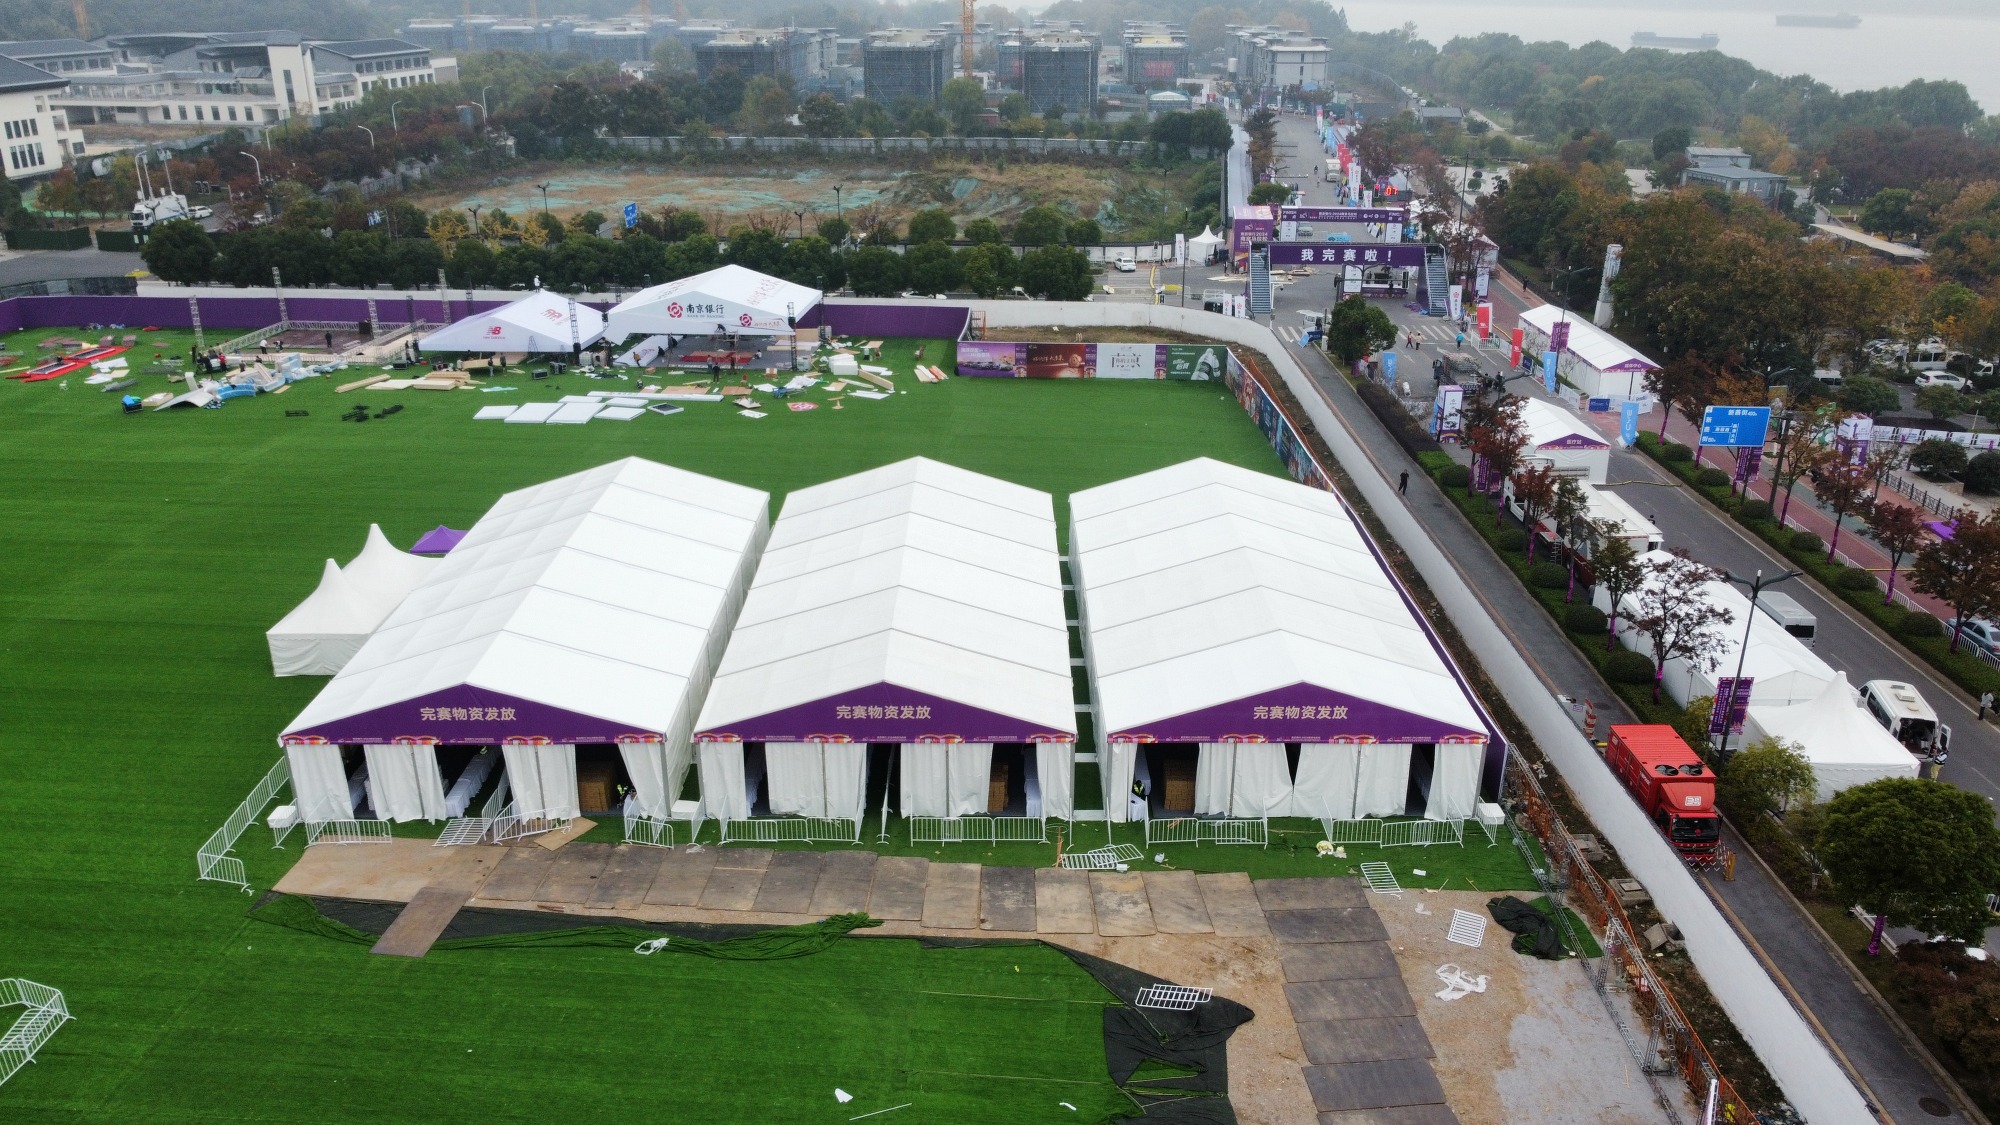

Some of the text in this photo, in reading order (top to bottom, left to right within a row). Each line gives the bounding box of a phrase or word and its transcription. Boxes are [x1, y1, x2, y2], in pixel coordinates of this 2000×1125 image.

[1301, 249, 1391, 262] 我完赛啦！
[686, 303, 725, 314] 南京银行
[420, 706, 517, 721] 完赛物资发放
[836, 704, 932, 720] 完赛物资发放
[1253, 705, 1349, 720] 完赛物资发放
